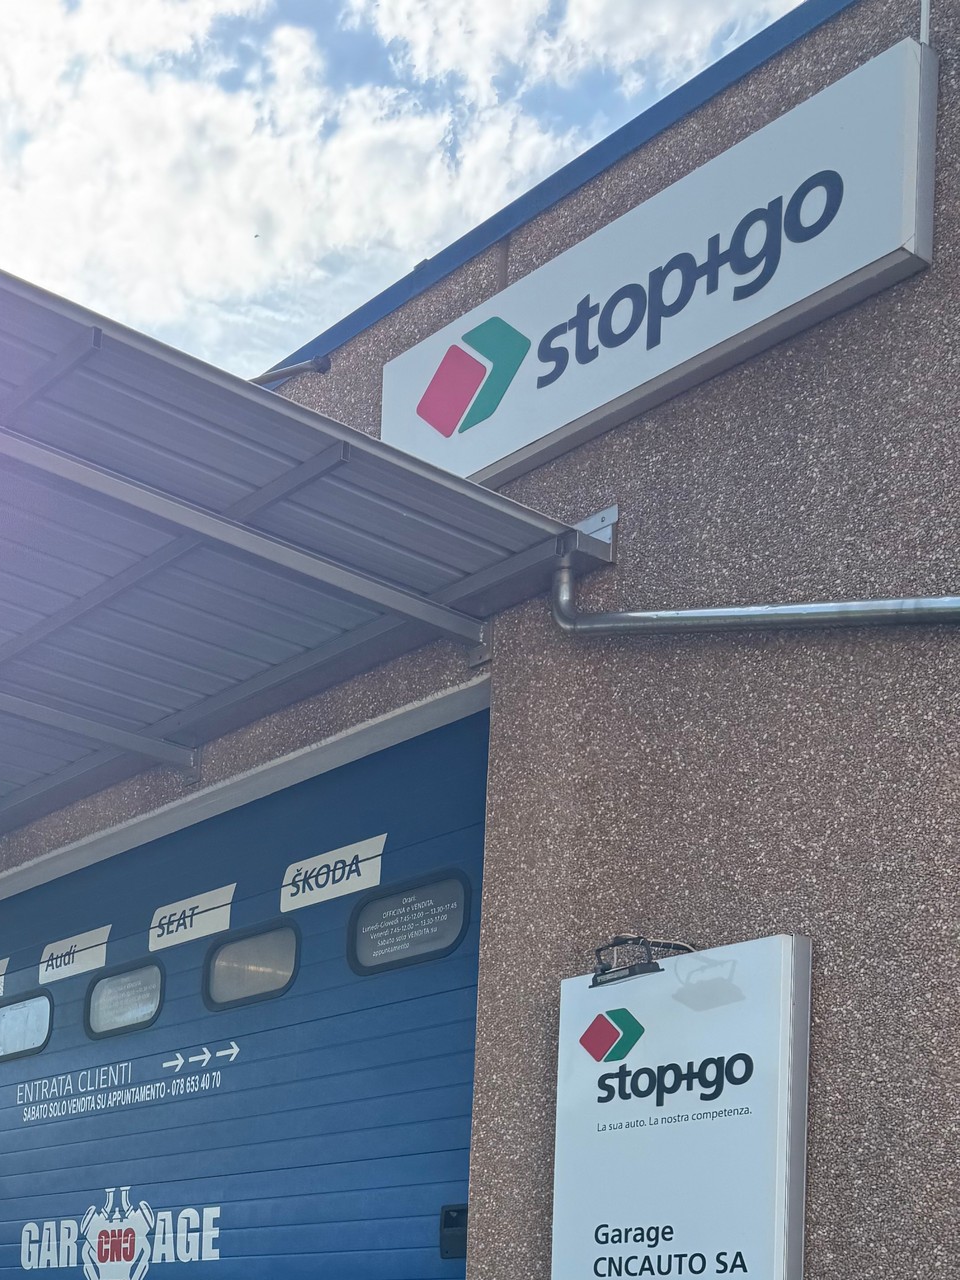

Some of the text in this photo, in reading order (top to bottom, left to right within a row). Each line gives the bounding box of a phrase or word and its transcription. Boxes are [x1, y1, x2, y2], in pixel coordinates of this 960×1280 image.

[537, 169, 844, 389] stop+go
[289, 854, 362, 898] ŠKODA
[156, 905, 199, 938] SEAT
[45, 944, 77, 972] Audi
[16, 1061, 133, 1105] ENTRATA CLIENTI
[22, 1104, 48, 1122] SABATO
[48, 1101, 67, 1118] SOLO
[67, 1096, 96, 1115] VENDITA
[96, 1093, 107, 1109] SU
[106, 1082, 166, 1108] APPUNTAMENTO
[171, 1078, 185, 1095] 078
[186, 1075, 199, 1093] 653
[200, 1073, 210, 1090] 40
[211, 1071, 221, 1088] 70
[597, 1053, 754, 1107] stop+go
[597, 1106, 753, 1132] La sua auto. La nostra competenza.
[594, 1222, 674, 1248] Garage
[593, 1251, 748, 1278] CNCAUTO SA
